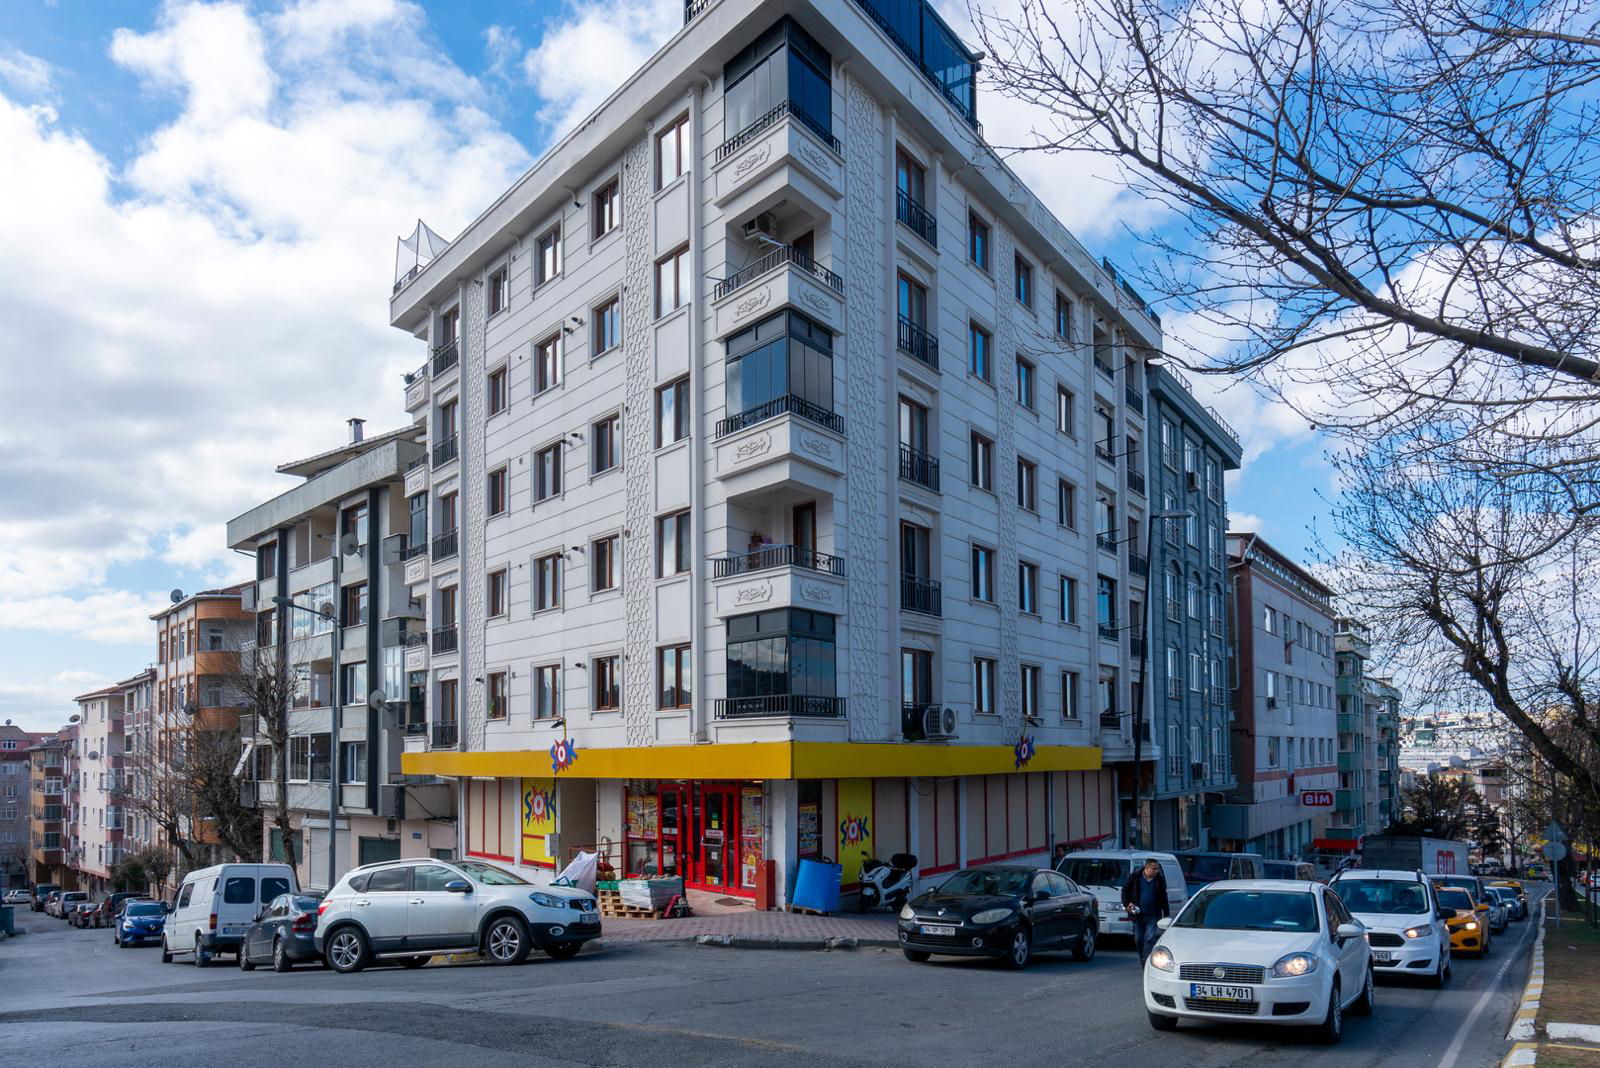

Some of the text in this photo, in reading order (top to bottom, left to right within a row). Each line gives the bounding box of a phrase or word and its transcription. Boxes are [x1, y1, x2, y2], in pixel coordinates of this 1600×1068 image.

[1197, 986, 1249, 998] 34 LH 4701
